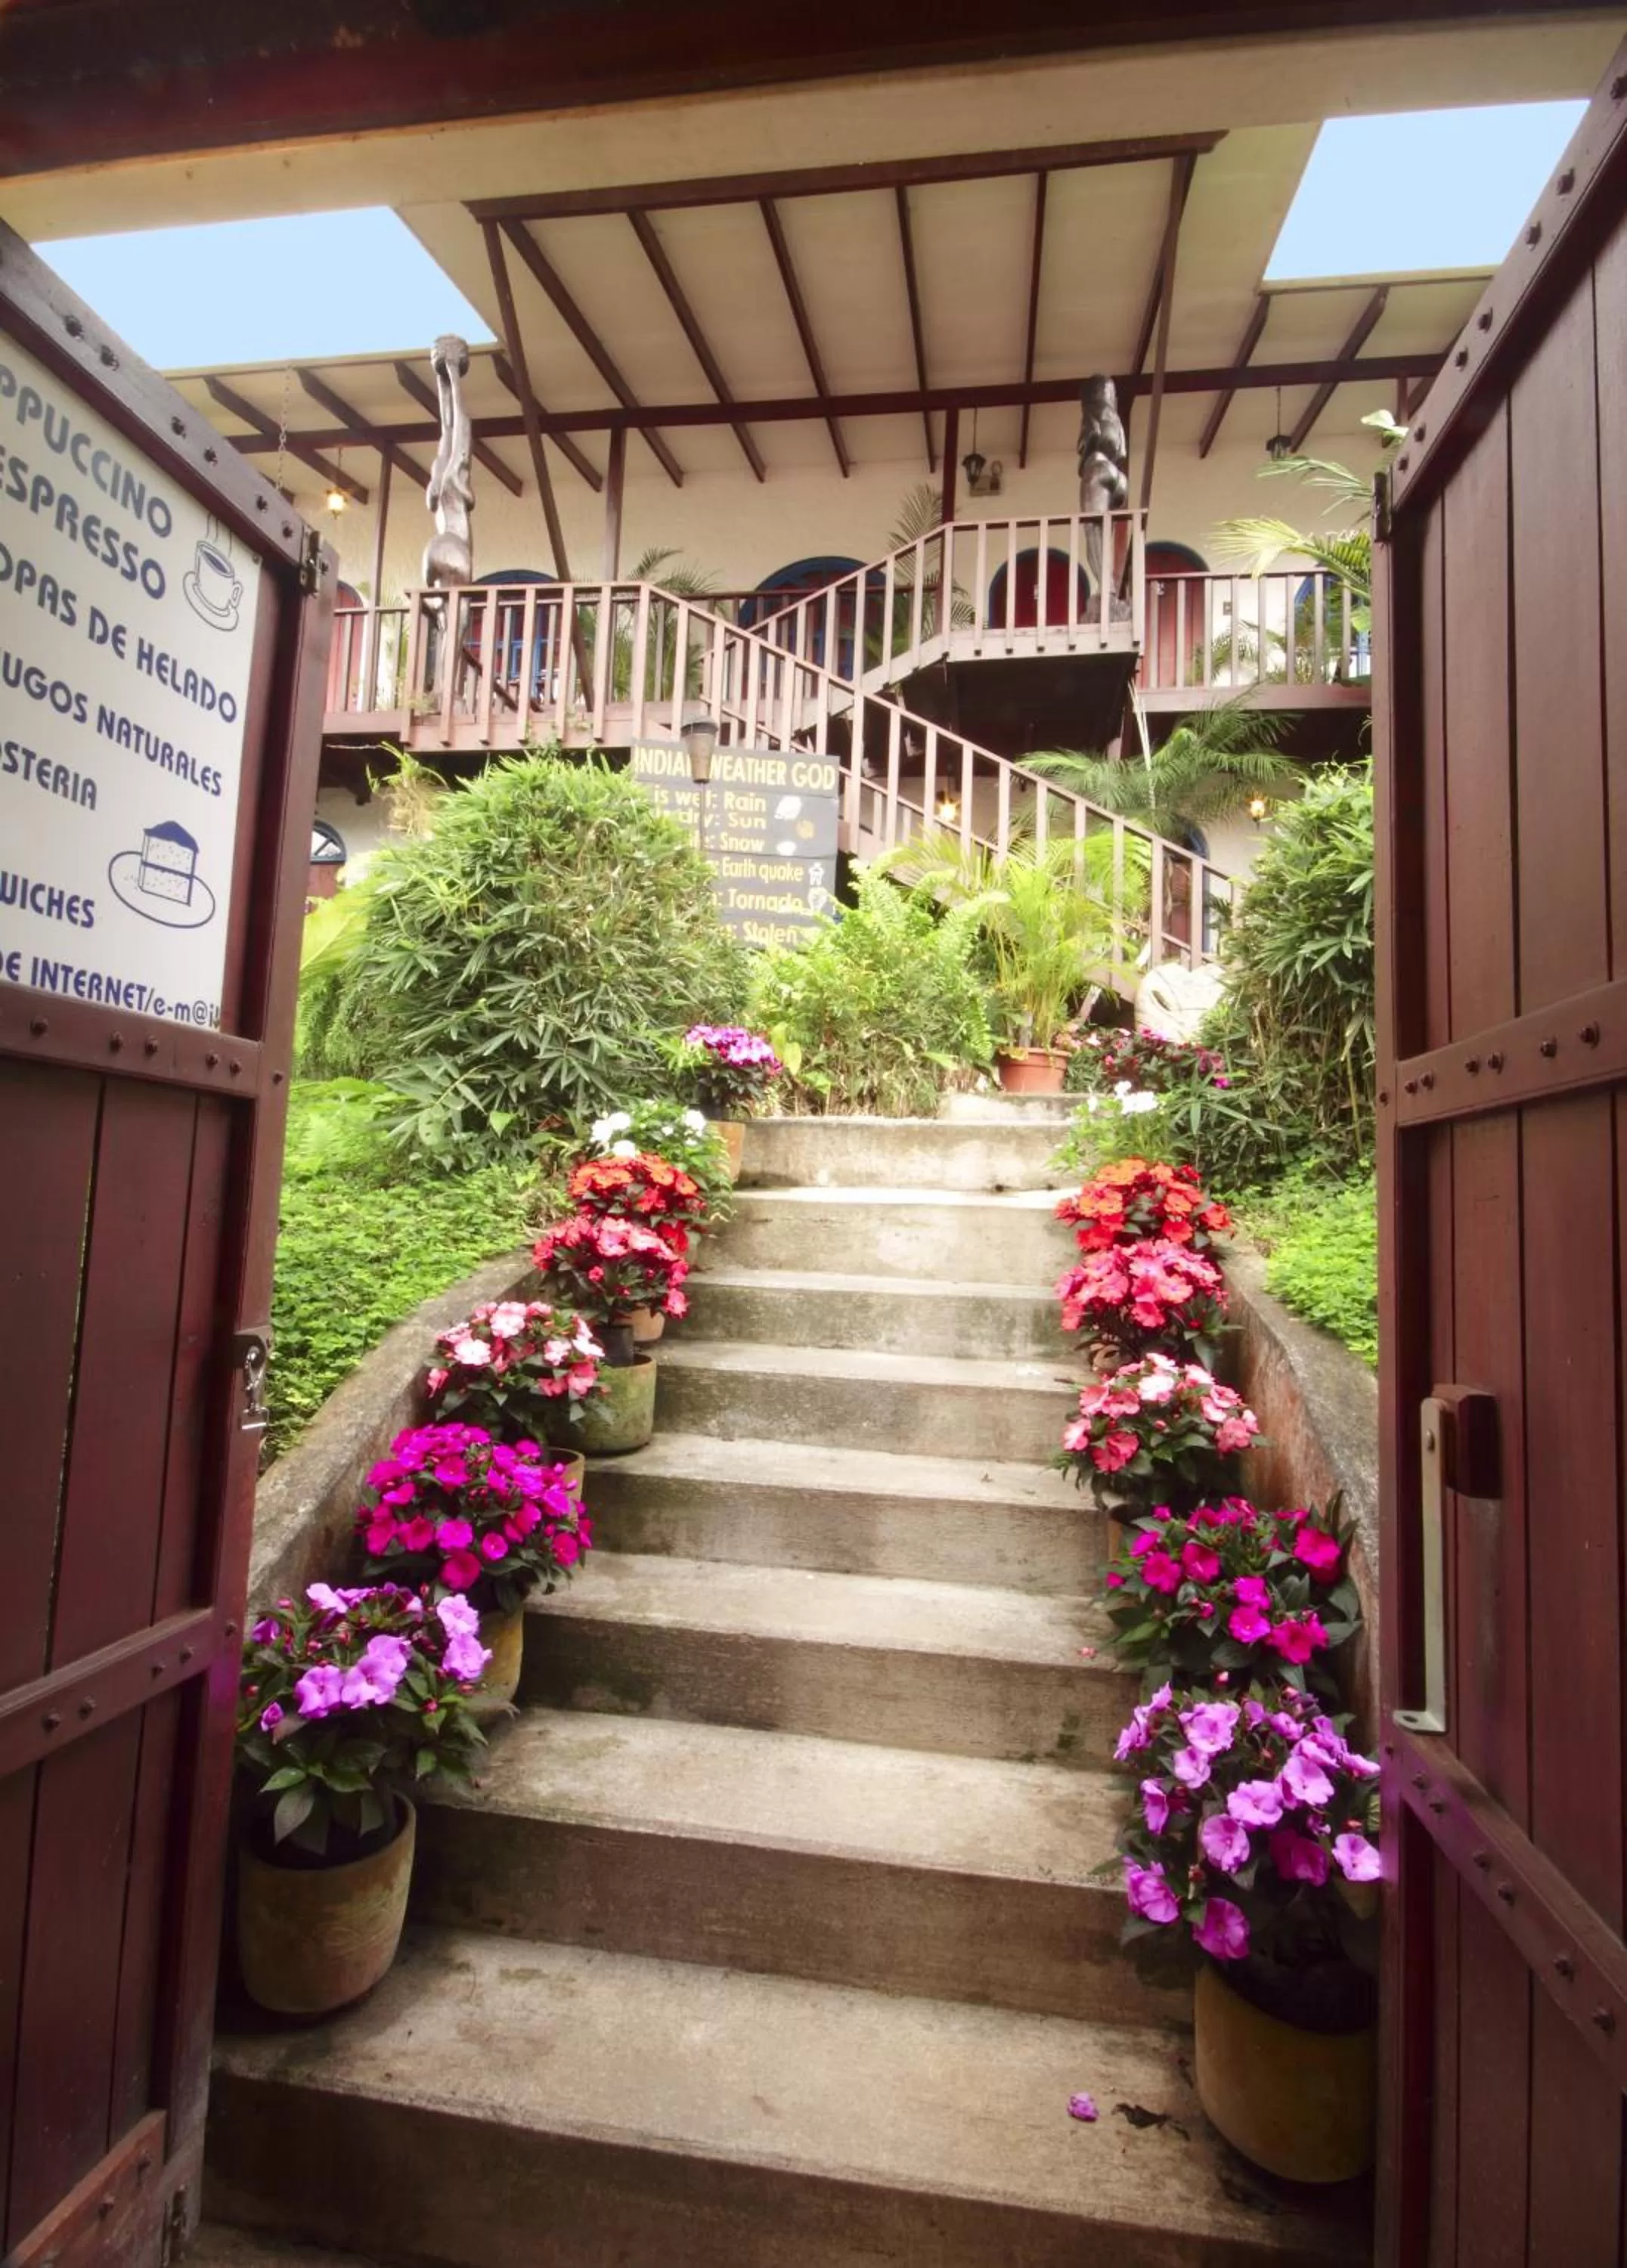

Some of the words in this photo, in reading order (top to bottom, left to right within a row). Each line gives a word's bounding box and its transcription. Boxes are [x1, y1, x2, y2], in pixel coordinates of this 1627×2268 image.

[0, 443, 166, 600] SPRESSO
[88, 606, 127, 660] DE
[136, 637, 237, 723] HELADO
[97, 705, 222, 797] NATURALES
[0, 740, 98, 810] STERIA
[792, 762, 836, 791] GOD
[724, 791, 767, 812] Rain
[728, 812, 767, 829] Sun
[720, 832, 765, 853] Snow
[728, 888, 803, 912] Tornado
[0, 949, 22, 983] E
